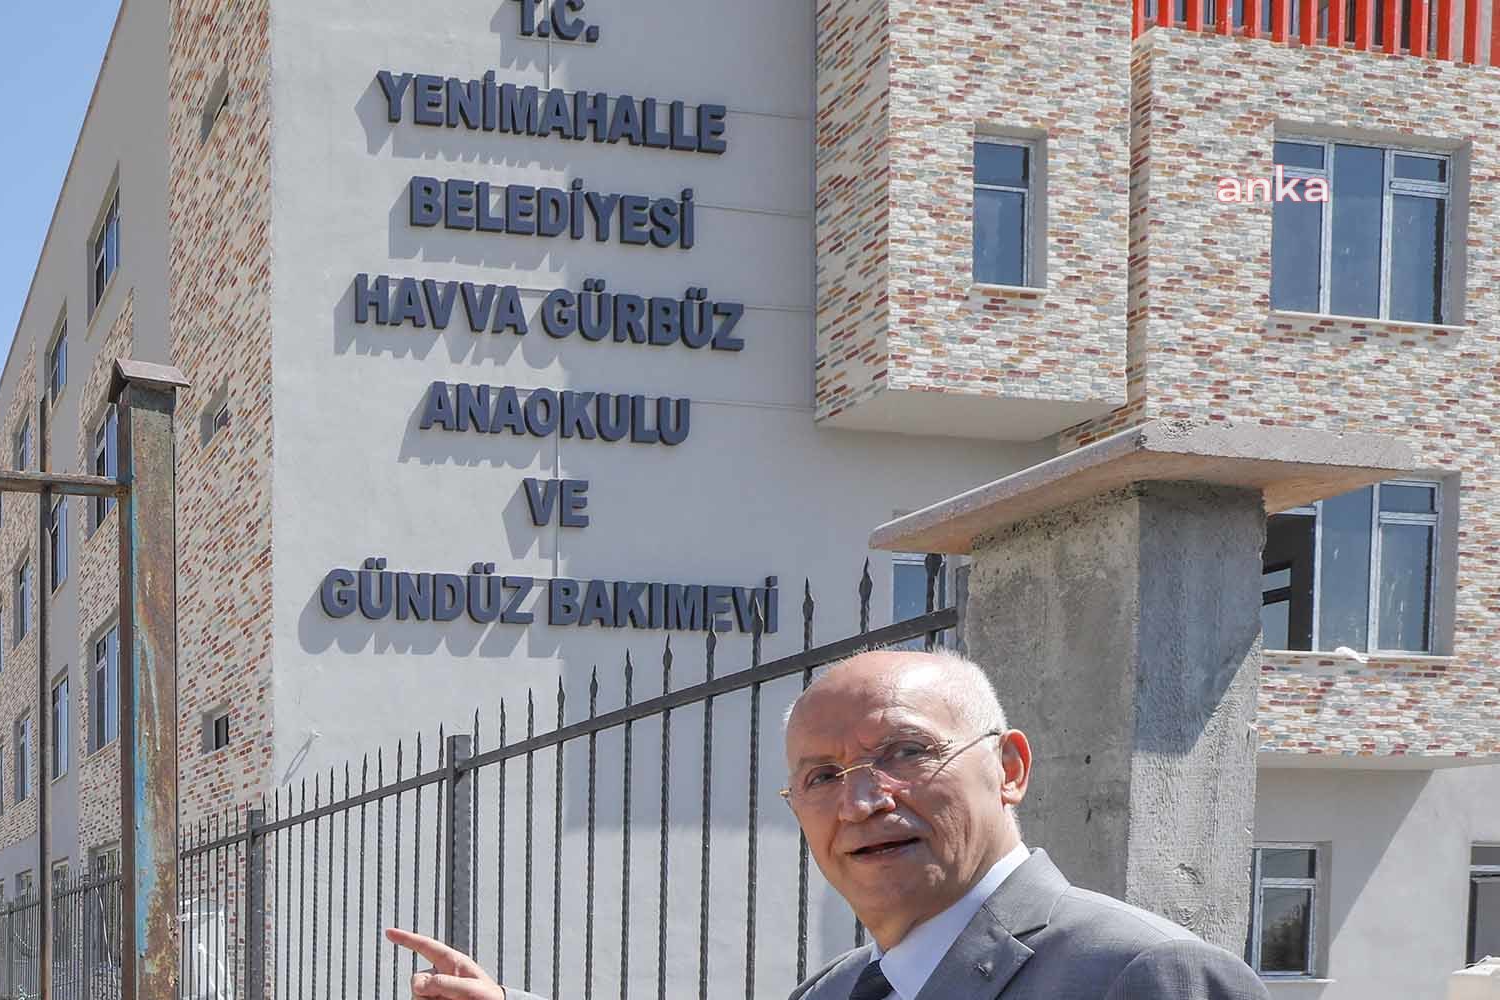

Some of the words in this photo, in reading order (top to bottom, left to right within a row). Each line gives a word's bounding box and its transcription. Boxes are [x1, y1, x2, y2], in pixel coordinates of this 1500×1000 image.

[510, 0, 599, 43] T.C.
[377, 70, 727, 154] YENİMAHALLE
[409, 176, 695, 249] BELEDİYESİ
[355, 273, 528, 335] HAVVA
[541, 278, 745, 352] GÜRBÜZ
[419, 381, 691, 446] ANAOKULU
[524, 477, 590, 528] VE
[320, 557, 534, 625] GÜNDÜZ
[549, 576, 780, 634] BAKIMEVİ
